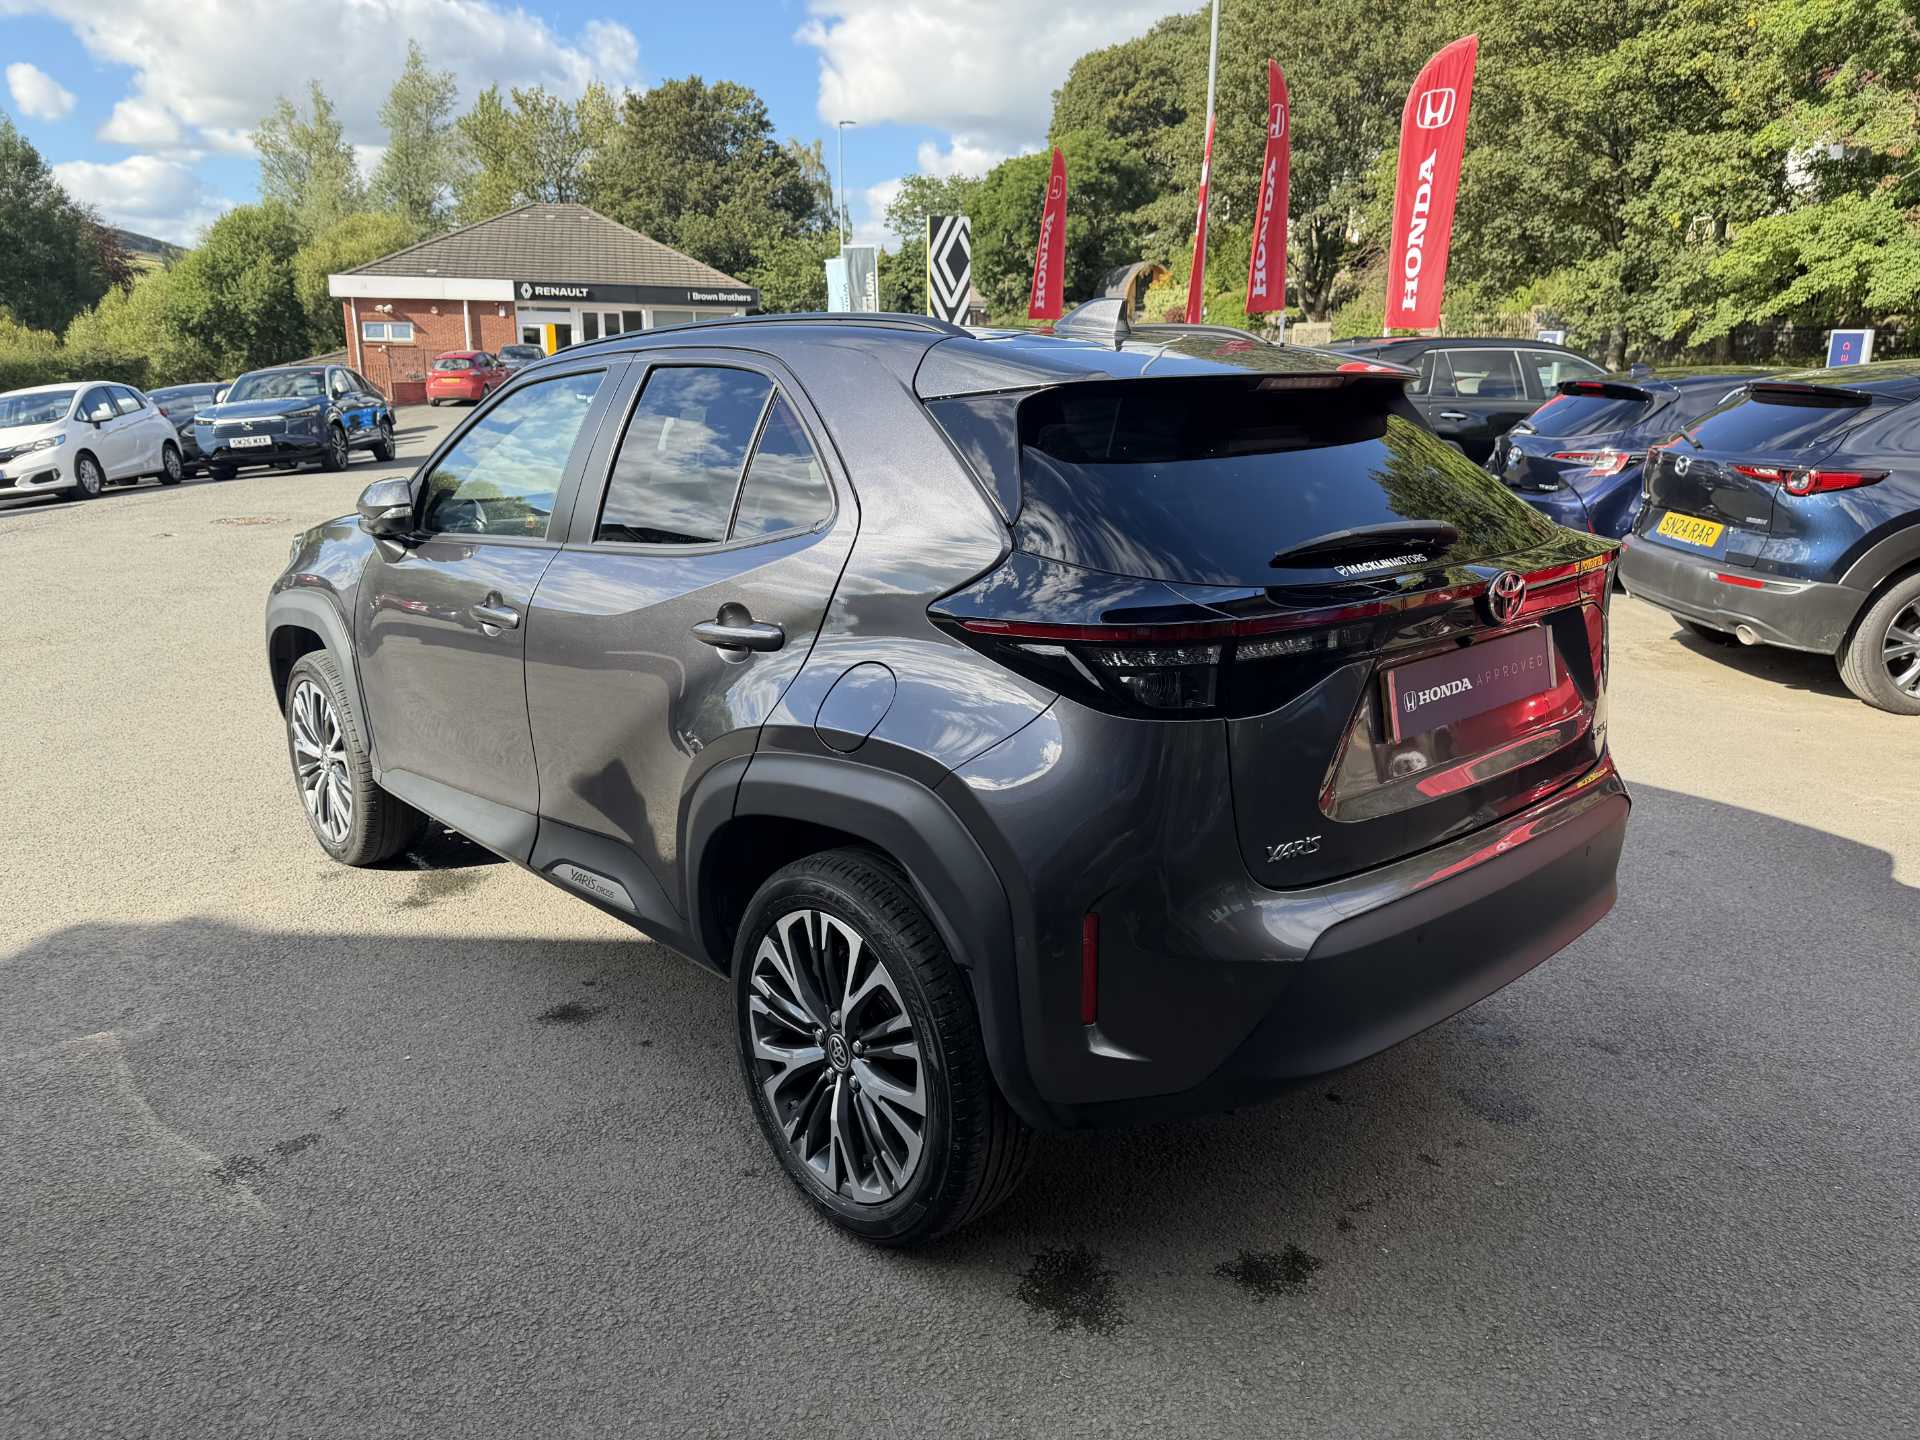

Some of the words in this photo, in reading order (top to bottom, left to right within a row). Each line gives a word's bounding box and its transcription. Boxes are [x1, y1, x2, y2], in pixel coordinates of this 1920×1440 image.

[1252, 157, 1277, 298] HONDA
[1402, 148, 1437, 311] HONDA
[1035, 212, 1055, 309] HONDA
[535, 286, 588, 297] RENAULT
[692, 291, 718, 301] Brown
[718, 292, 752, 302] Brothers
[1662, 516, 1690, 536] SN24
[1690, 523, 1715, 544] RAR
[1418, 677, 1473, 706] HONDA
[1476, 655, 1543, 687] APPROVED
